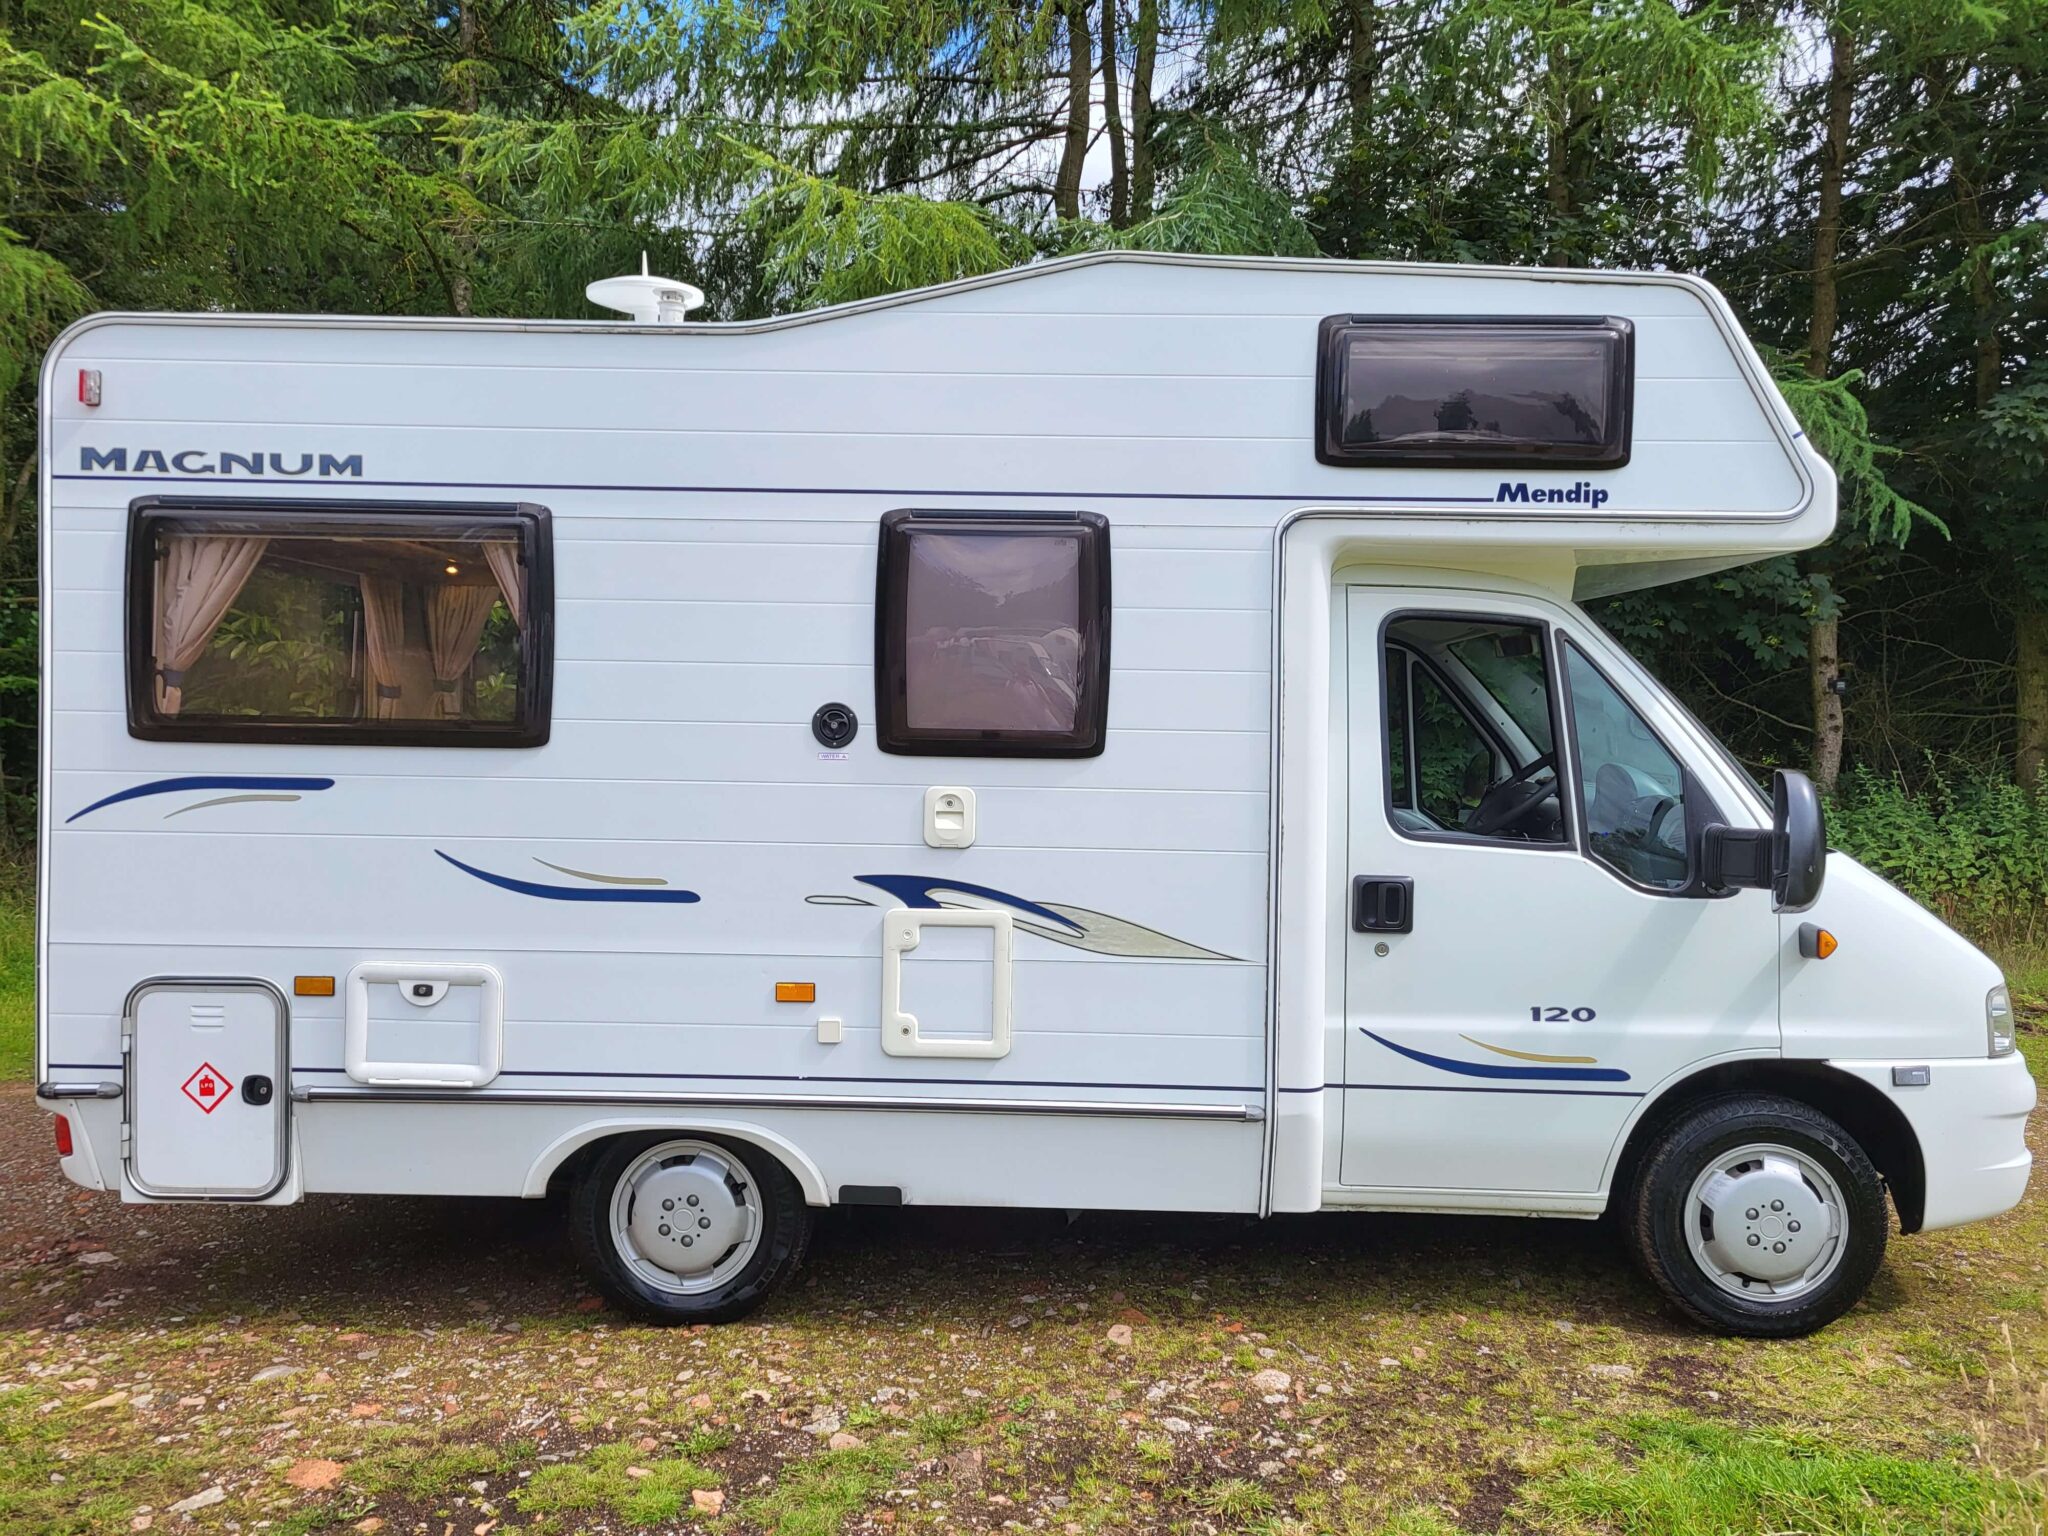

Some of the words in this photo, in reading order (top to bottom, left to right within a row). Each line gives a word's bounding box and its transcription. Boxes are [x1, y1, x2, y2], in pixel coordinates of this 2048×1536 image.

[80, 446, 363, 477] MAGNUM
[1496, 481, 1609, 509] Mendip
[1530, 1006, 1597, 1022] 120
